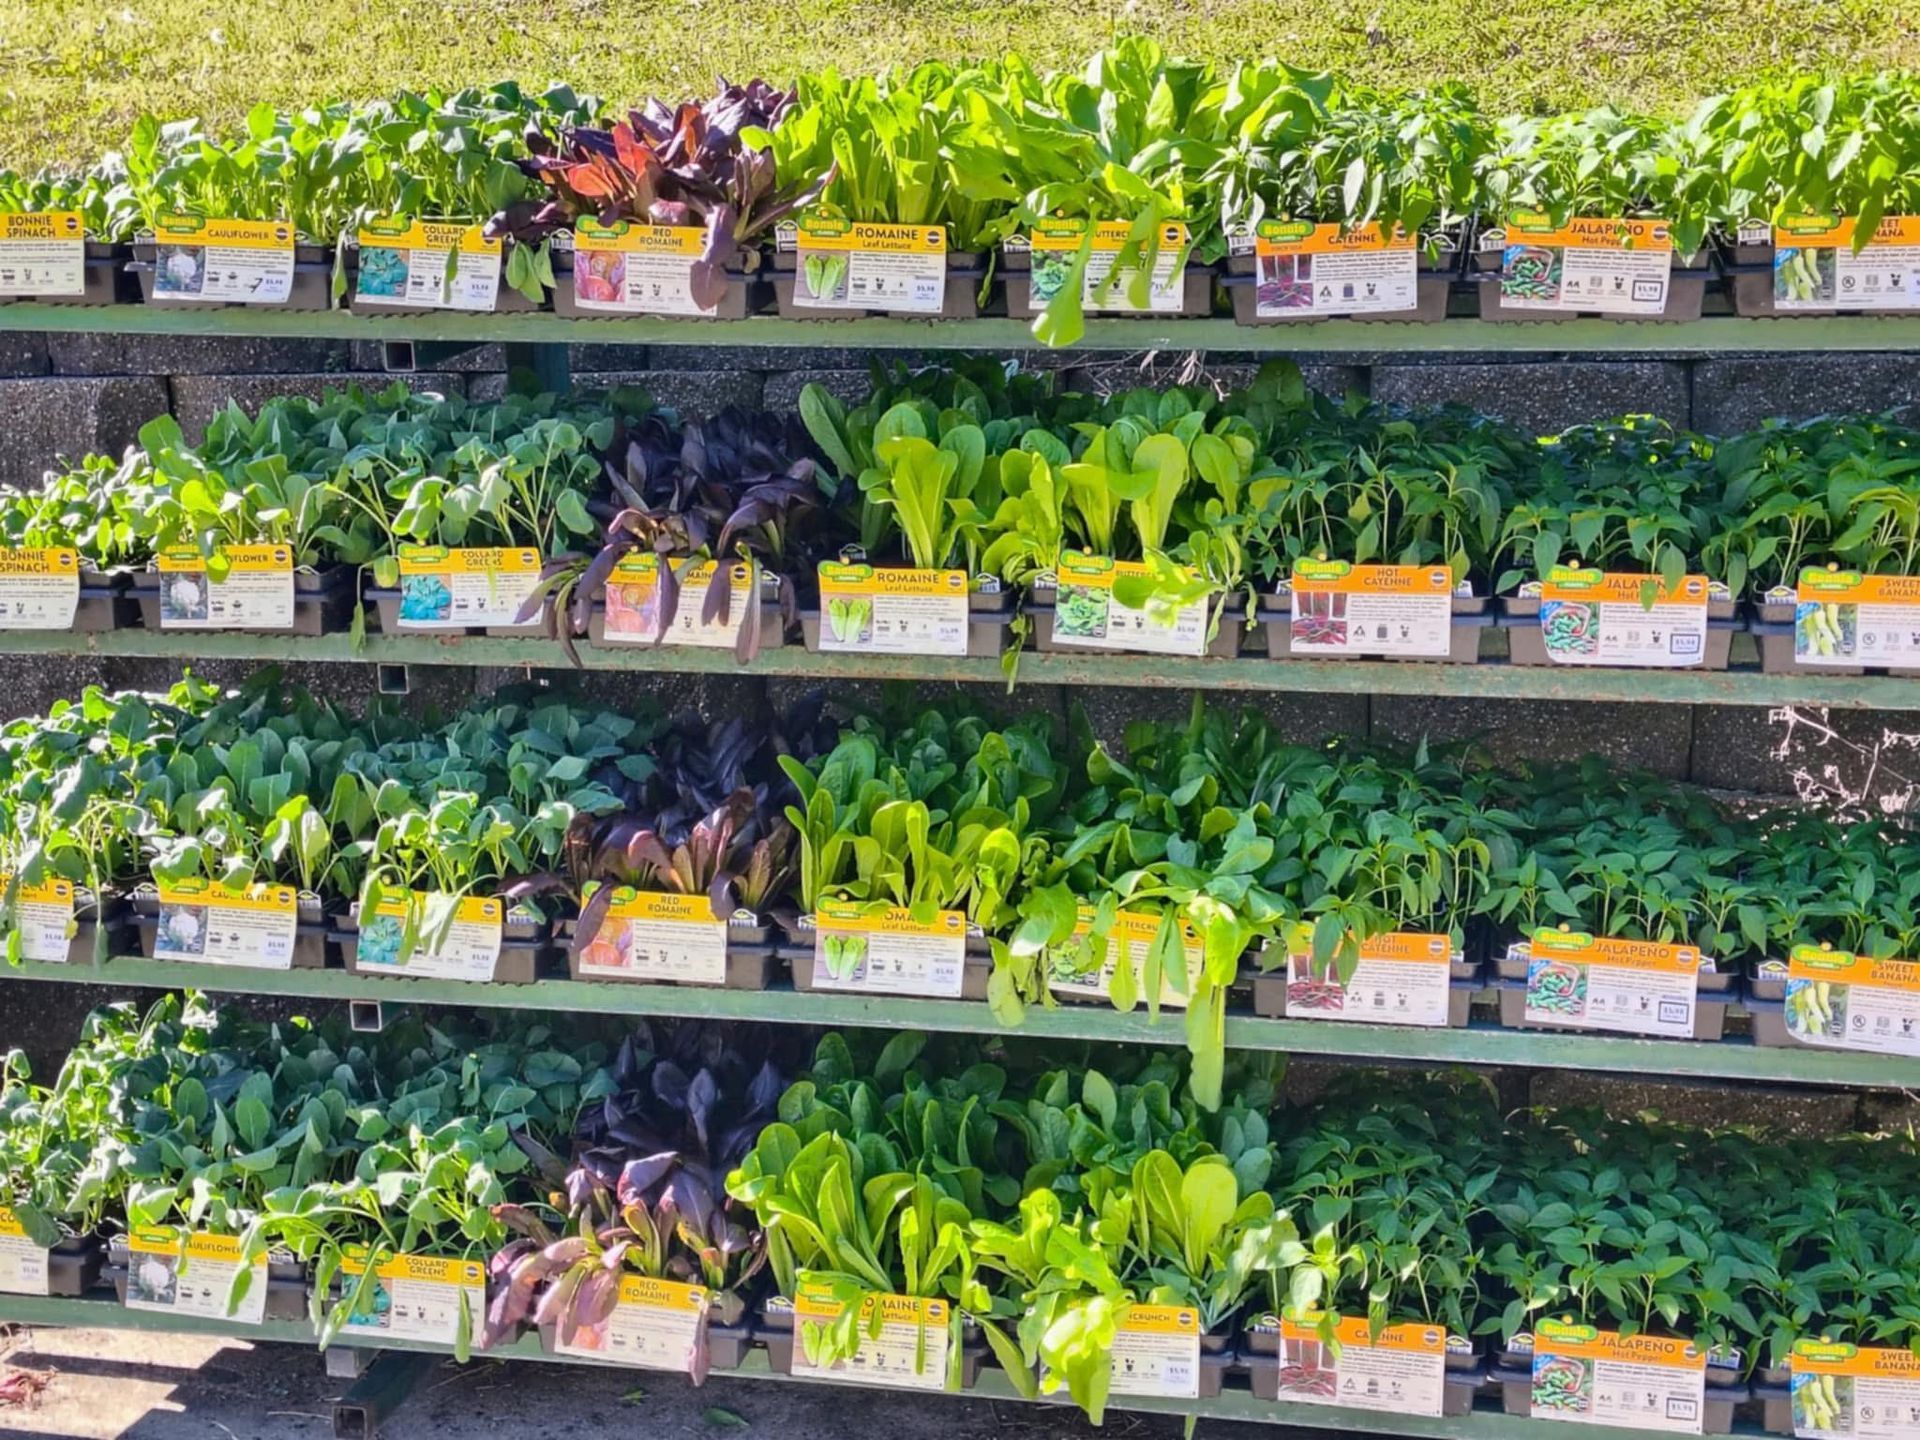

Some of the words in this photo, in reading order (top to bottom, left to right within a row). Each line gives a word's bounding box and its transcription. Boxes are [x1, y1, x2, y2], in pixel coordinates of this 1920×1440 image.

[8, 215, 53, 227] BONNIE
[1881, 219, 1899, 227] EET
[6, 227, 56, 238] SPINACH
[208, 229, 270, 240] CAULIFLOWER
[422, 225, 466, 236] COLLARD
[653, 228, 672, 237] RED
[856, 227, 918, 240] ROMAINE
[1264, 223, 1306, 236] Bonnie
[426, 234, 464, 245] GREENS
[640, 236, 684, 247] ROMAINE
[862, 240, 879, 249] Leaf
[881, 241, 912, 249] Lettuce
[1582, 236, 1598, 244] Hot
[1601, 238, 1623, 247] Pepp
[1, 550, 46, 562] BONNIE
[0, 562, 50, 573] SPINACH
[1377, 568, 1399, 576] HOT
[877, 572, 939, 584] ROMAINE
[1363, 576, 1412, 587] CAYENNE
[885, 584, 901, 592] Leaf
[660, 896, 680, 905] RED
[647, 903, 693, 915] ROMAINE
[881, 923, 899, 931] Leaf
[1625, 957, 1657, 967] Pepper
[1878, 962, 1914, 973] SWEET
[1871, 971, 1919, 984] BANANA
[405, 1257, 449, 1269] COLLARD
[409, 1266, 446, 1277] GREENS
[639, 1280, 659, 1290] RED
[625, 1288, 671, 1302] ROMAINE
[1355, 1329, 1404, 1343] CANNE
[1612, 1350, 1629, 1359] Hot
[1631, 1352, 1662, 1362] Pepper
